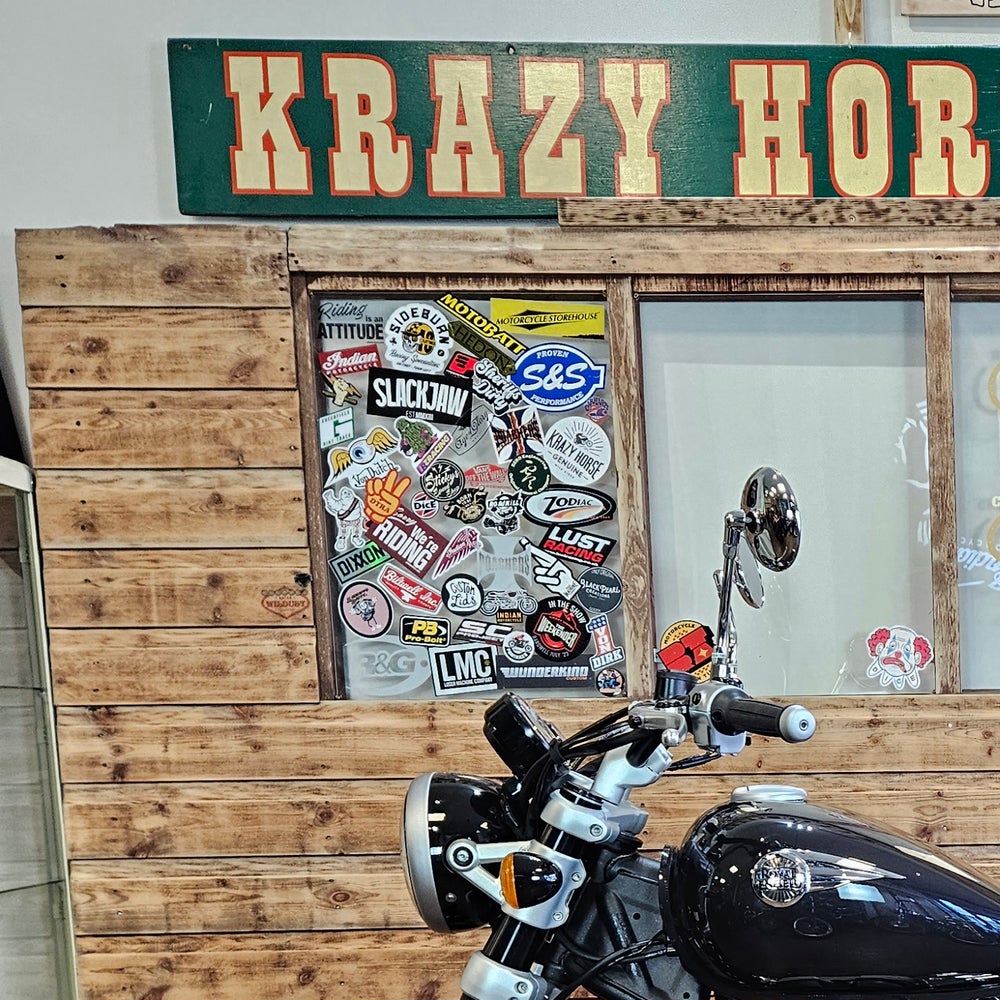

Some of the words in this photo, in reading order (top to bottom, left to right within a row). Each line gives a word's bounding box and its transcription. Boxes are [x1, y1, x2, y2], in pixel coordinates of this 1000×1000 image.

[222, 50, 670, 199] KRAZY
[320, 301, 368, 320] Riding
[365, 315, 372, 323] is
[374, 315, 384, 323] an
[495, 314, 547, 326] MOTORCYCLE
[549, 311, 600, 322] STOREHOUSE
[317, 322, 384, 341] ATTITUDE
[389, 306, 450, 345] SIDEBURN
[440, 293, 526, 355] MOTOBATT
[454, 326, 509, 370] HEDON
[536, 350, 570, 360] PROVEN
[321, 351, 380, 371] Indian
[519, 361, 589, 392] S&S
[372, 377, 470, 417] SLACKJAW
[531, 391, 585, 406] PERFORMANCE
[405, 410, 415, 419] EST
[546, 430, 576, 459] KRAZY
[573, 449, 606, 480] HORSE
[552, 453, 585, 479] GENUINE
[478, 472, 490, 482] THE
[544, 495, 595, 516] ZODIAC
[371, 518, 433, 572] RIDING
[409, 523, 440, 554] We're
[548, 525, 612, 551] LUST
[336, 544, 387, 578] DIXXON
[543, 540, 605, 564] RACING
[496, 611, 522, 619] INDIAN
[548, 600, 557, 609] IN
[557, 599, 570, 610] THE
[569, 602, 587, 624] SHOW
[411, 620, 438, 637] PB
[459, 620, 514, 636] SC
[536, 615, 579, 649] WEEKENDER
[663, 623, 696, 645] MOTORCYCLE
[359, 650, 417, 676] R&G
[438, 649, 493, 682] LMC
[592, 650, 624, 669] DIRK
[500, 666, 589, 679] WUNDERKIND
